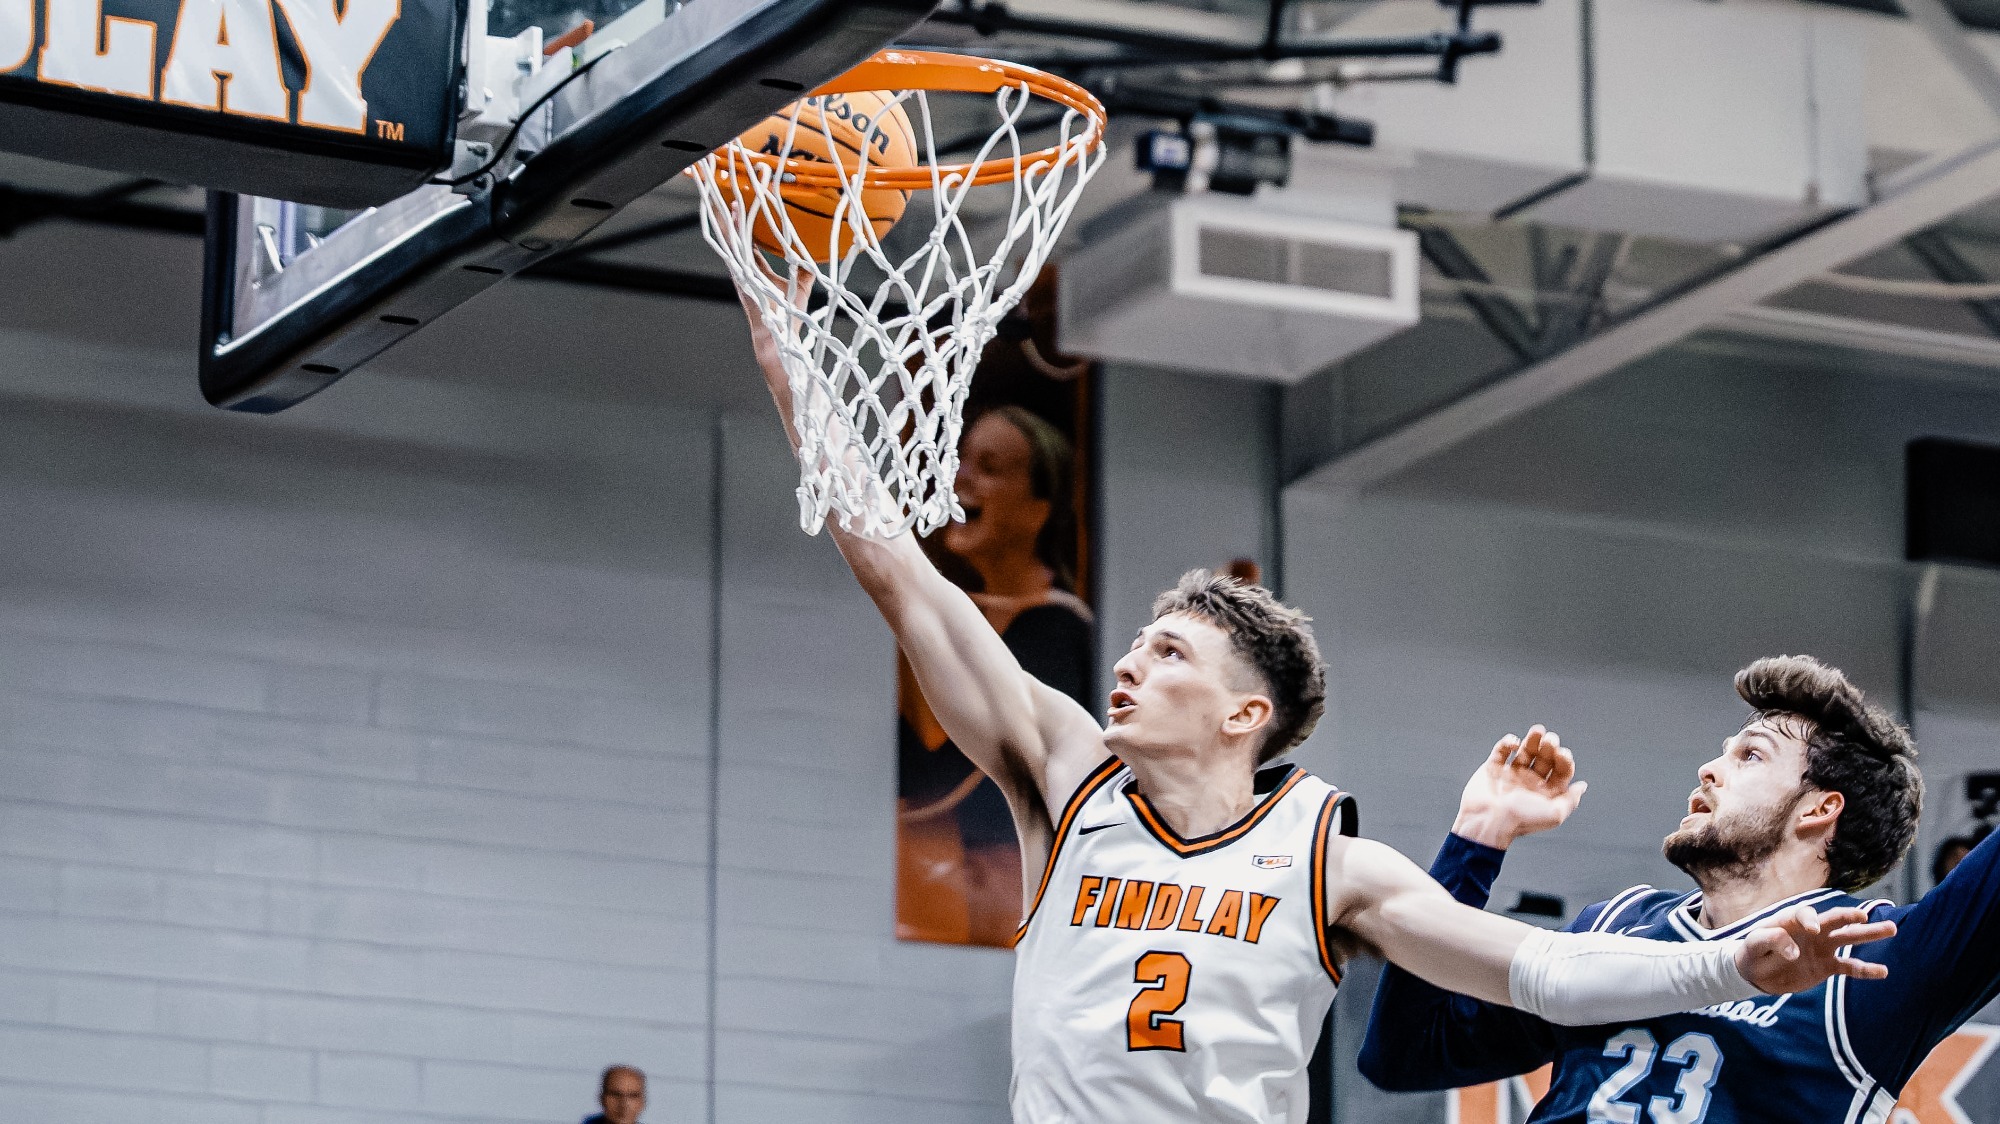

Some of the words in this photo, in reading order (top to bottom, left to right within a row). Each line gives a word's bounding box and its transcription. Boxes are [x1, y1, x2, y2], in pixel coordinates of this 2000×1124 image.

[375, 119, 404, 142] TM
[1069, 874, 1283, 945] FINDLAY
[1126, 949, 1193, 1053] 2
[1586, 1028, 1724, 1124] 23
